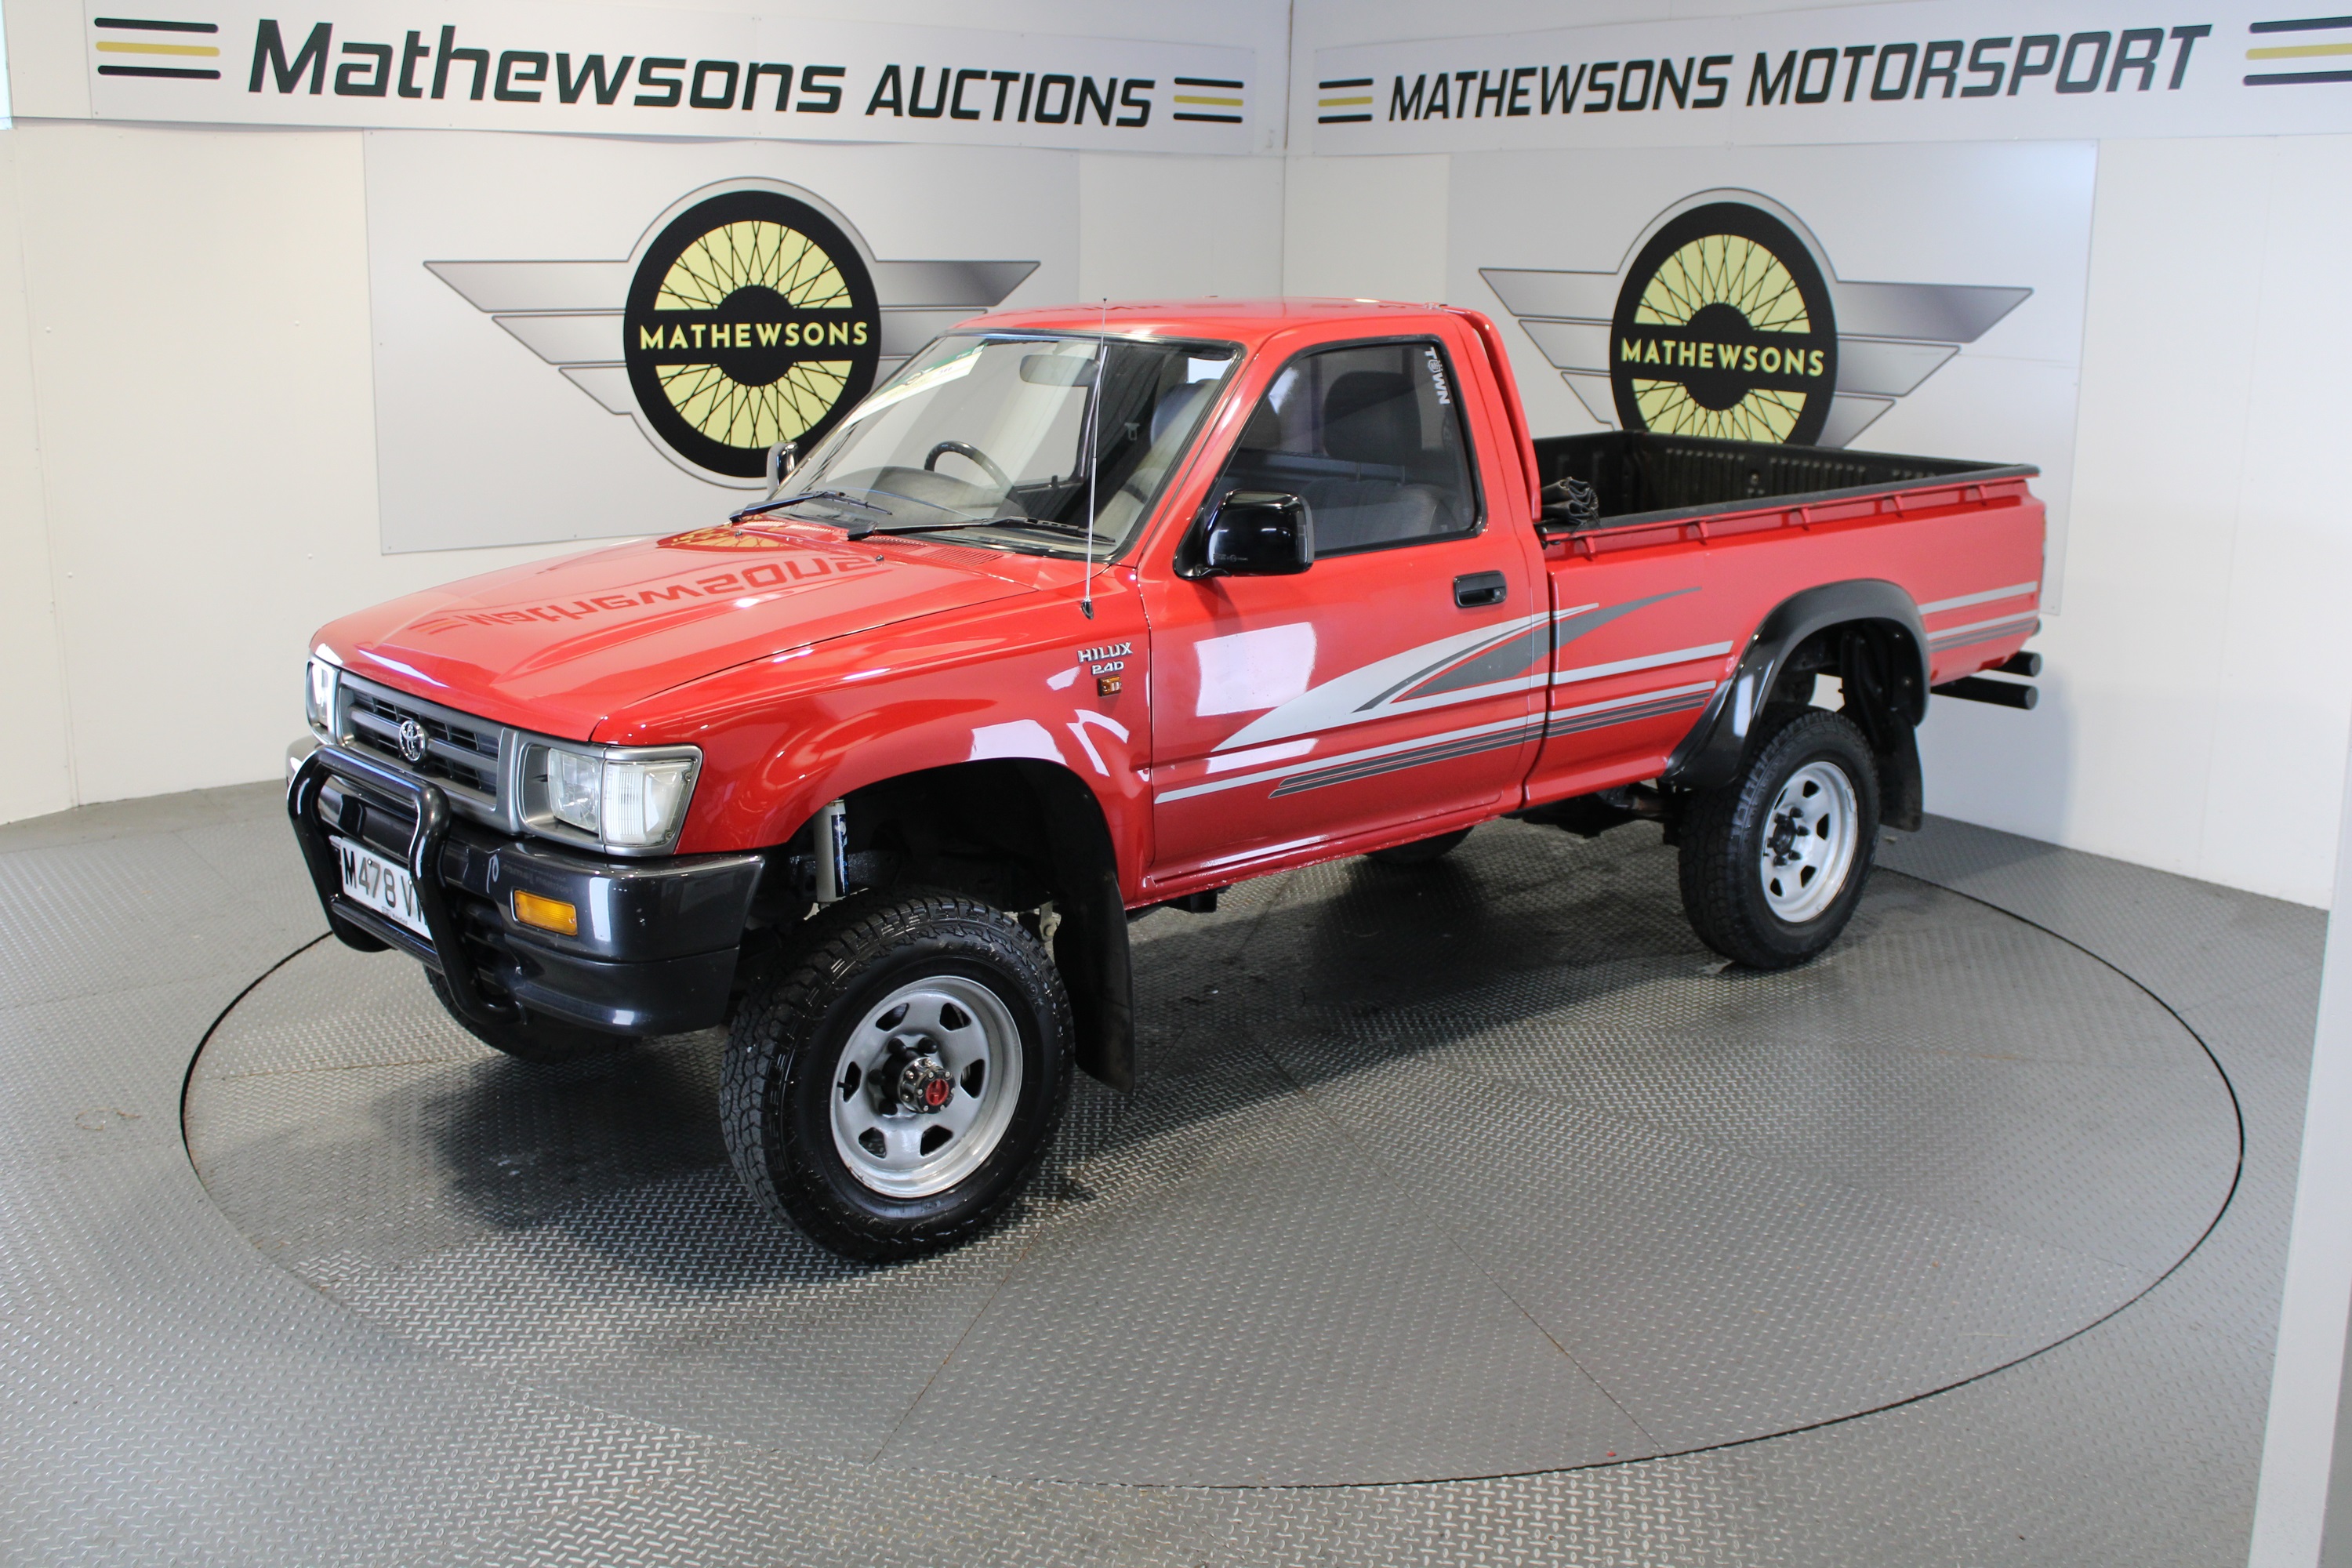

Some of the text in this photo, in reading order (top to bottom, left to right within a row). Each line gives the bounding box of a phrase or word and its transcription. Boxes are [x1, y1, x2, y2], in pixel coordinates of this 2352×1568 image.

[248, 18, 1156, 129] Mathewsons AUCTIONS
[1388, 23, 2213, 122] MATHEWSONS MOTORSPORT
[639, 321, 869, 350] MATHEWSONS
[1621, 337, 1825, 377] MATHEWSONS
[1076, 641, 1133, 663] HILUX
[1091, 660, 1124, 676] 2.4D
[342, 847, 397, 909] M478
